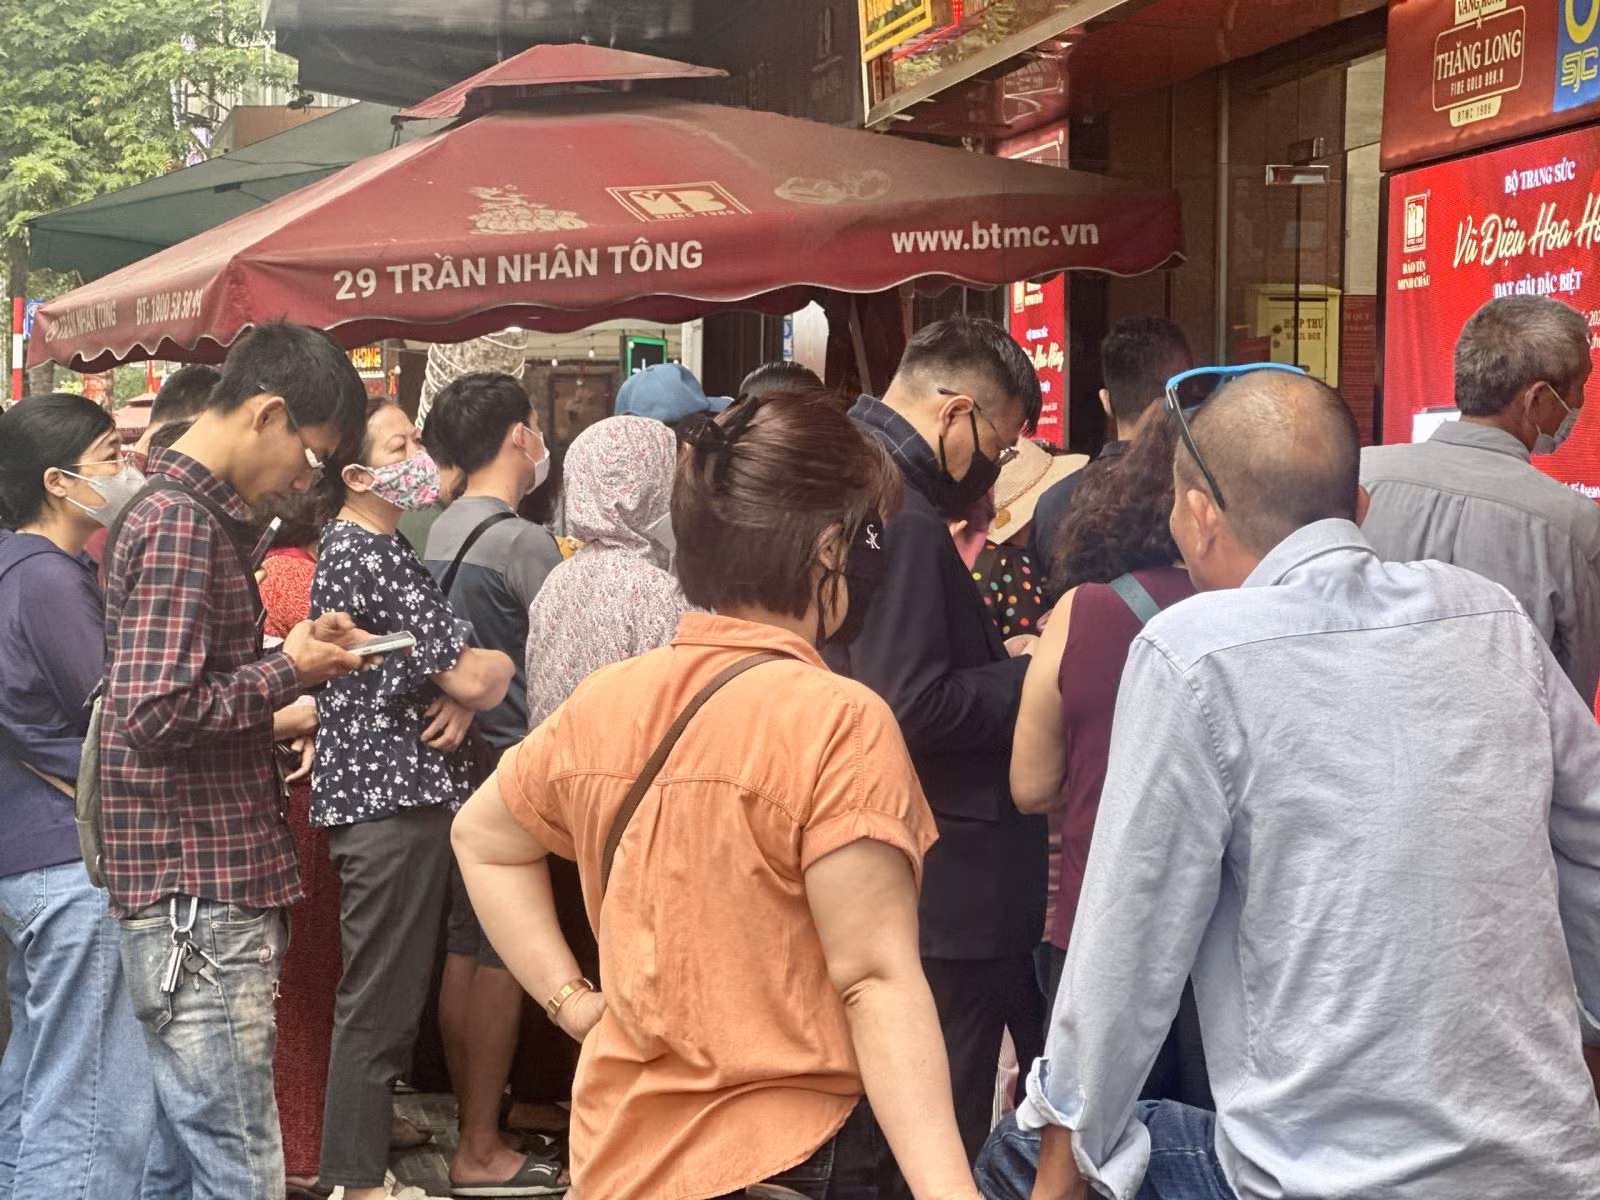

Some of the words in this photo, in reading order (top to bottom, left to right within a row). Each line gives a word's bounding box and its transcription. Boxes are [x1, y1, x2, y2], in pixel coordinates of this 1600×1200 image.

[1436, 41, 1481, 80] THĂNG
[1484, 29, 1521, 66] LONG
[1451, 80, 1465, 97] FINE
[1467, 75, 1482, 92] GOLD
[1504, 169, 1519, 197] BỘ
[1520, 165, 1552, 190] TRANG
[1554, 157, 1576, 183] SỨC
[892, 220, 1099, 254] www.btmc.vn
[1528, 201, 1572, 257] Hoa
[333, 268, 377, 300] 29
[386, 252, 486, 294] TRẦN
[498, 243, 598, 284] NHÂN
[607, 236, 703, 274] TÔNG
[1559, 267, 1582, 295] BIỆT
[151, 292, 170, 324] 1800
[1284, 317, 1305, 329] HP
